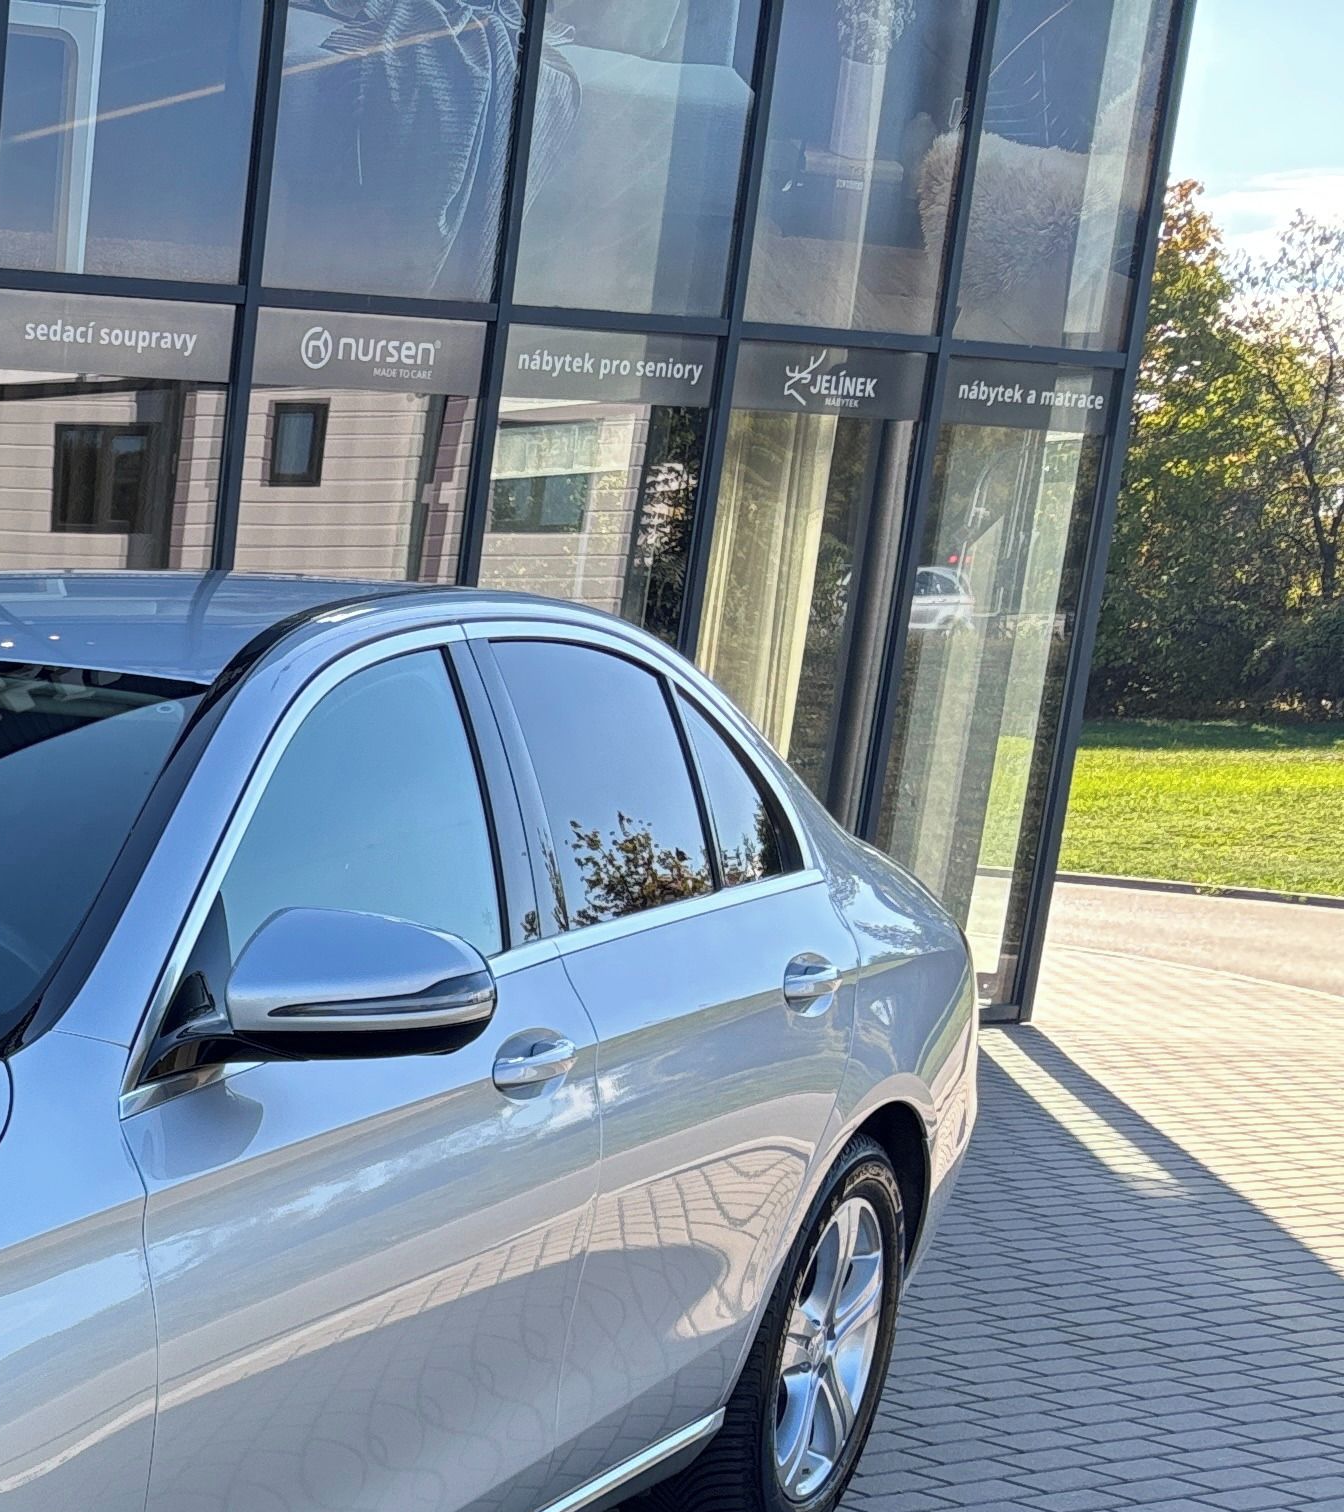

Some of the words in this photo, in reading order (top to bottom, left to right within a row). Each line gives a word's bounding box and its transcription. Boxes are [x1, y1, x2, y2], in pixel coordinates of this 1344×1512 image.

[24, 319, 95, 344] sedací
[99, 326, 198, 357] soupravy
[337, 337, 436, 366] nursen
[373, 367, 398, 378] MADE
[398, 368, 411, 379] TO
[411, 369, 433, 380] CARE
[517, 349, 596, 377] nábytek
[599, 357, 631, 380] pro
[635, 357, 704, 385] seniory
[809, 369, 878, 398] JELÍNEK
[958, 378, 1024, 407] nábytek
[1026, 388, 1036, 404] a
[1040, 389, 1105, 410] matrace
[824, 394, 860, 409] NÁBYTEK
